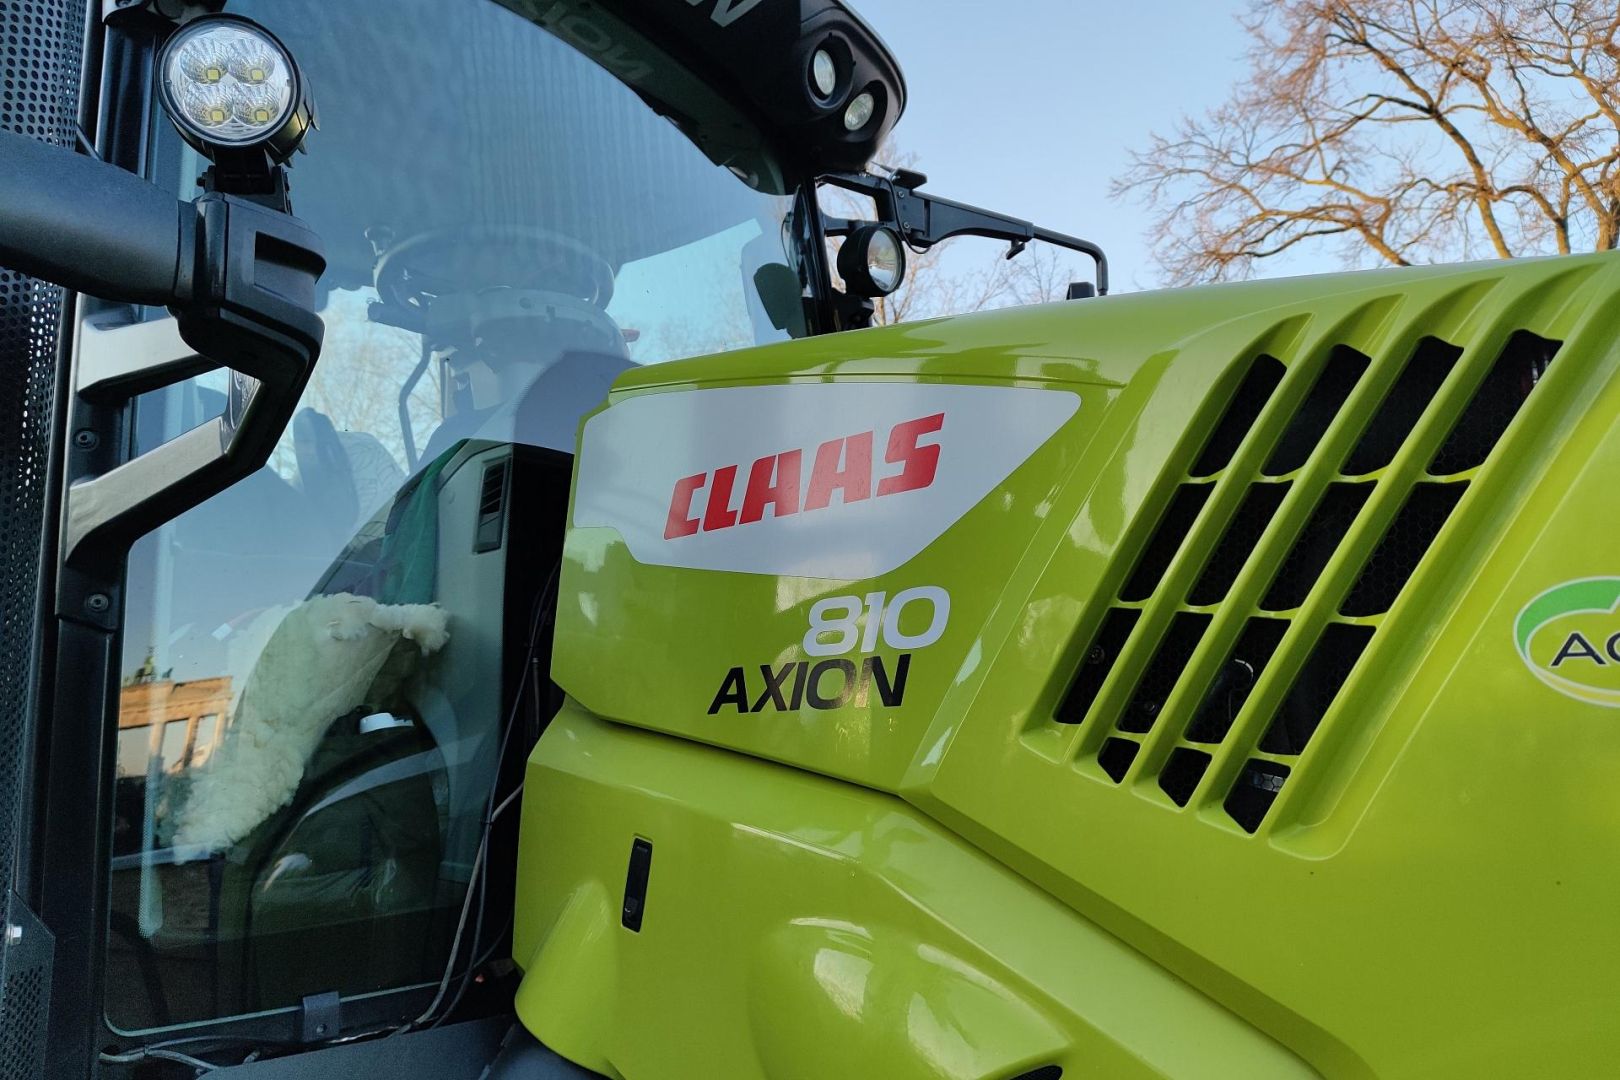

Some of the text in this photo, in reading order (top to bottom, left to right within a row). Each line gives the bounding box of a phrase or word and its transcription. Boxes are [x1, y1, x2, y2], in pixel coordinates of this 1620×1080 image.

[664, 412, 945, 540] CLAAS
[803, 586, 950, 657] 810
[707, 653, 911, 715] AXION
